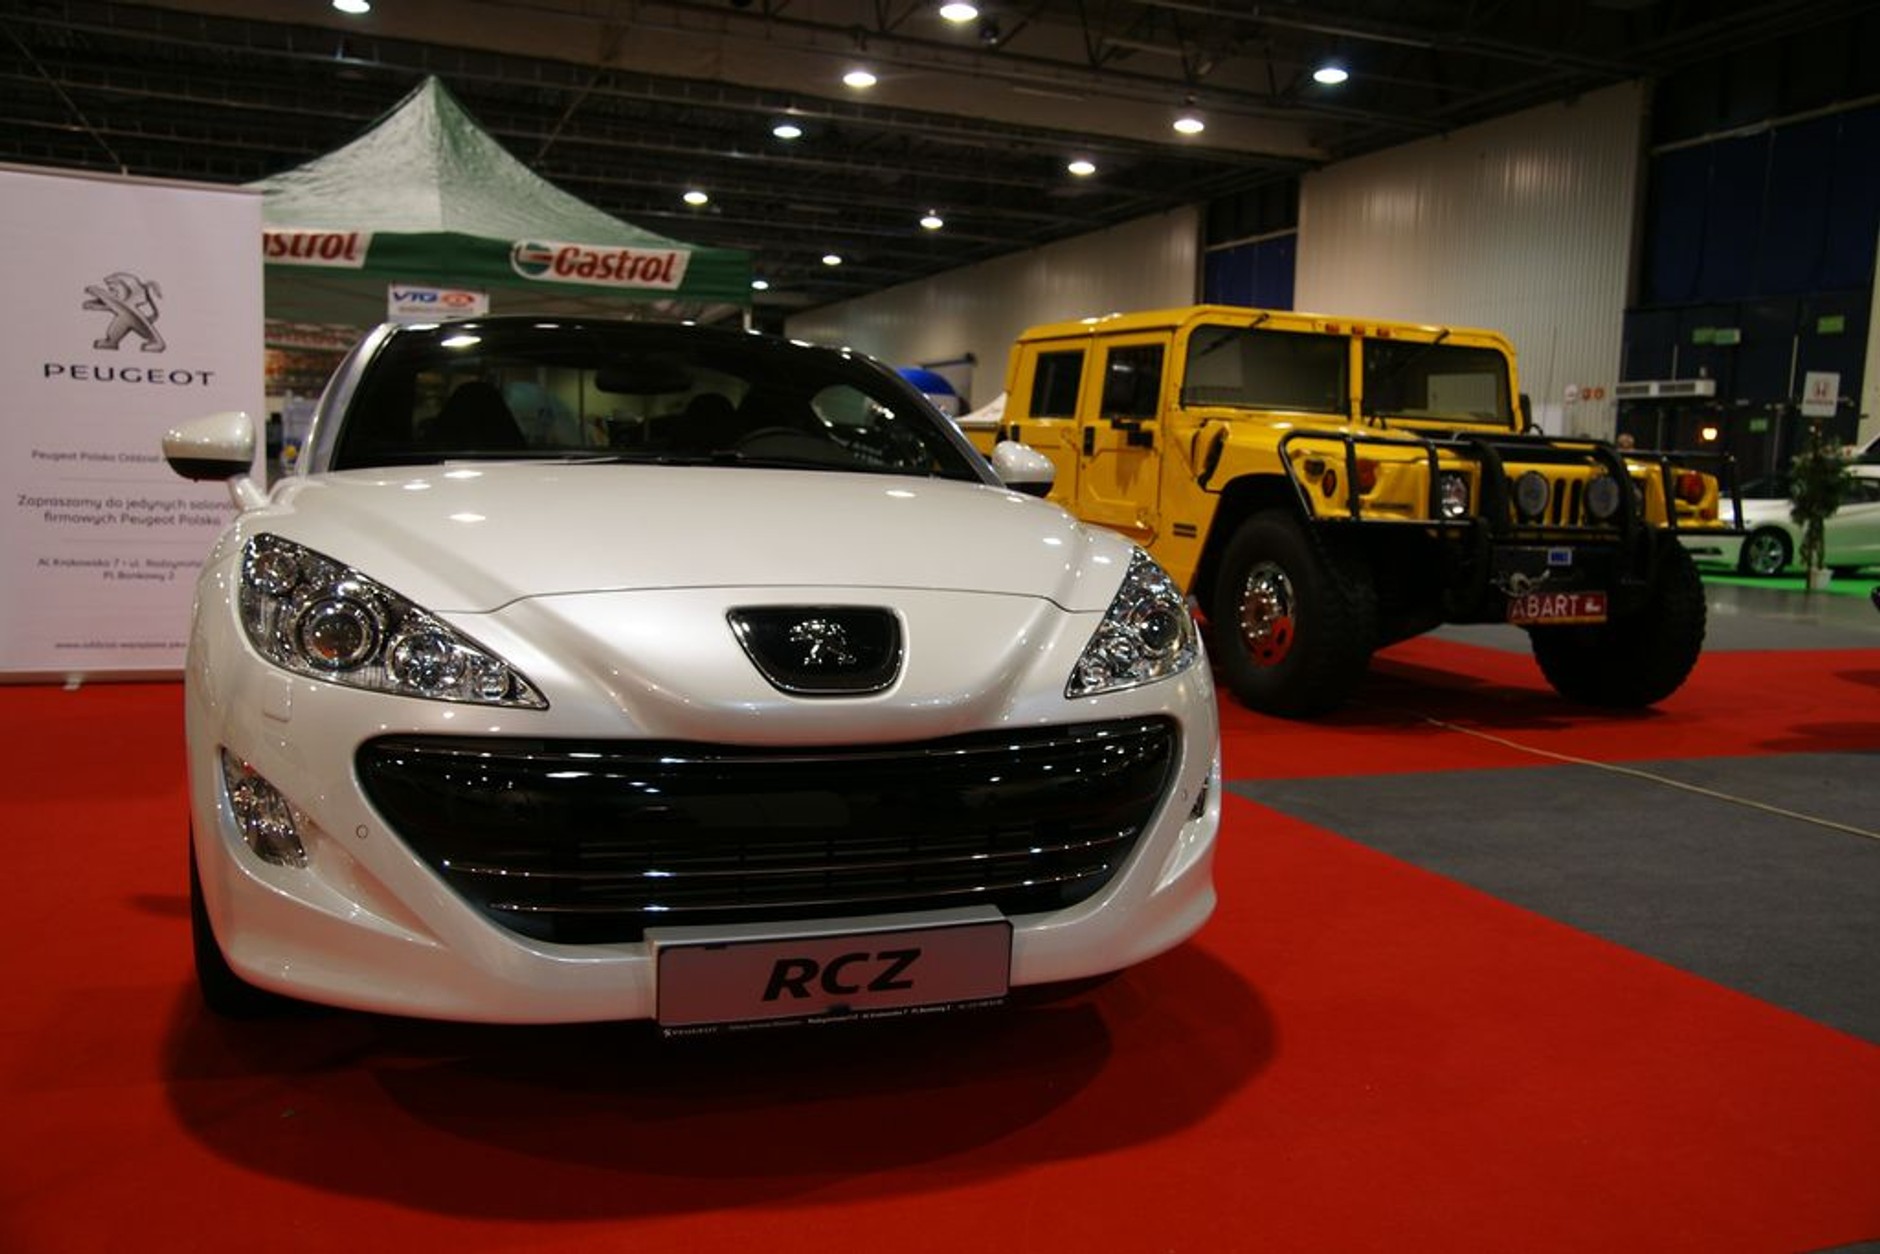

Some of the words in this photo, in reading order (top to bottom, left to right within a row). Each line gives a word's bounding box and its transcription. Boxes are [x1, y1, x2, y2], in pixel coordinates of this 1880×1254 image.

[555, 247, 676, 283] Castrol
[44, 363, 214, 386] PEUGEOT
[17, 493, 102, 509] Zapraszamy
[106, 494, 123, 507] do
[126, 495, 187, 512] jedynych
[44, 511, 116, 525] firmowych
[121, 513, 175, 527] Peugeot
[178, 513, 221, 525] Polska
[1511, 594, 1580, 618] ABART
[762, 948, 922, 1002] RCZ
